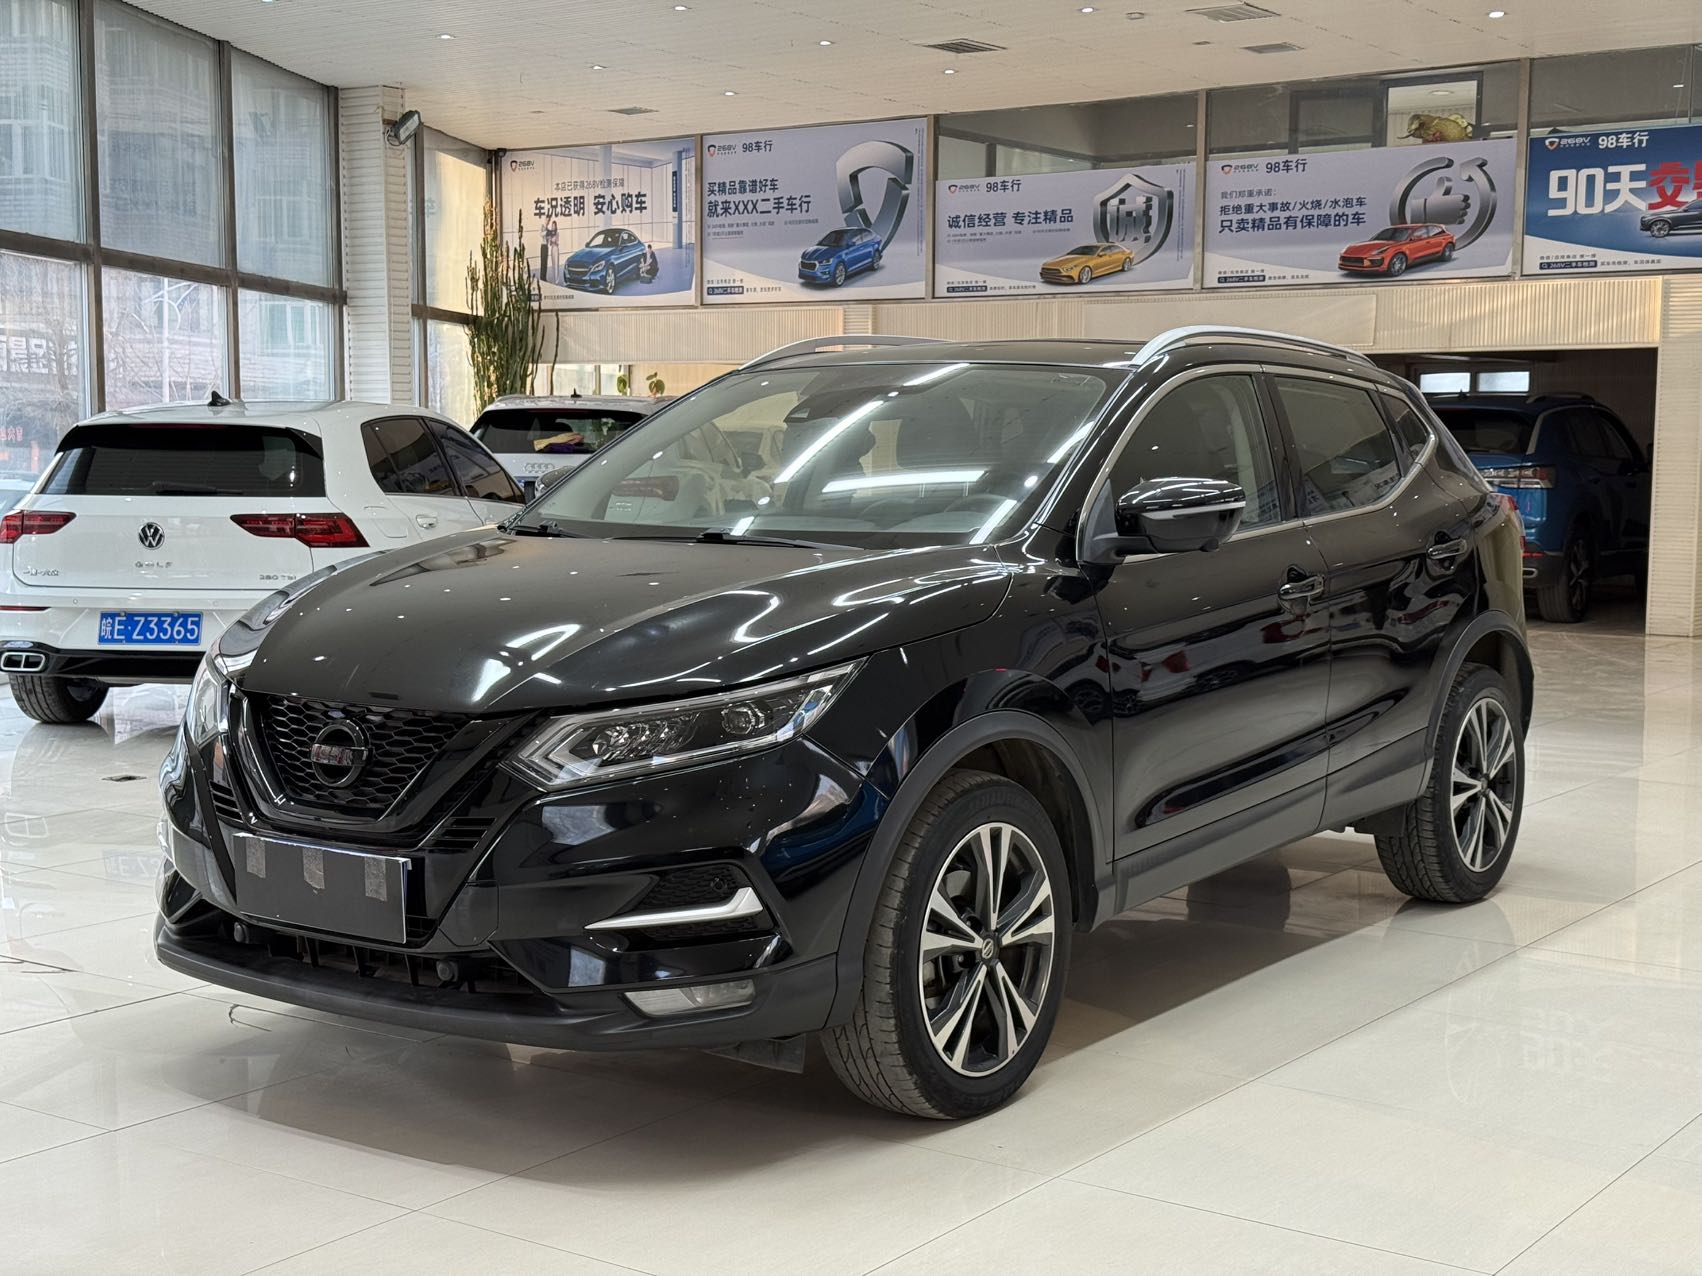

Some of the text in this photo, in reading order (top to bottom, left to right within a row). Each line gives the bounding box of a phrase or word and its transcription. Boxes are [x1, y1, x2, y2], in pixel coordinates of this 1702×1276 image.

[742, 140, 773, 153] 98车行
[1598, 131, 1650, 149] 98车行
[1265, 158, 1308, 174] 98车行
[707, 178, 779, 197] 买精品靠谱好车
[986, 179, 1022, 193] 98车行
[1547, 160, 1702, 217] 90天交
[533, 195, 585, 219] 车况透明
[593, 191, 648, 215] 安心购车
[707, 194, 811, 218] 就来XXX二手车行
[1219, 196, 1367, 216] 拒绝重大事故/火烧/水泡车
[947, 208, 1074, 230] 诚信经营 专注精品
[1219, 211, 1367, 234] 只卖精品有保障的车
[101, 616, 200, 641] 皖E·Z3365
